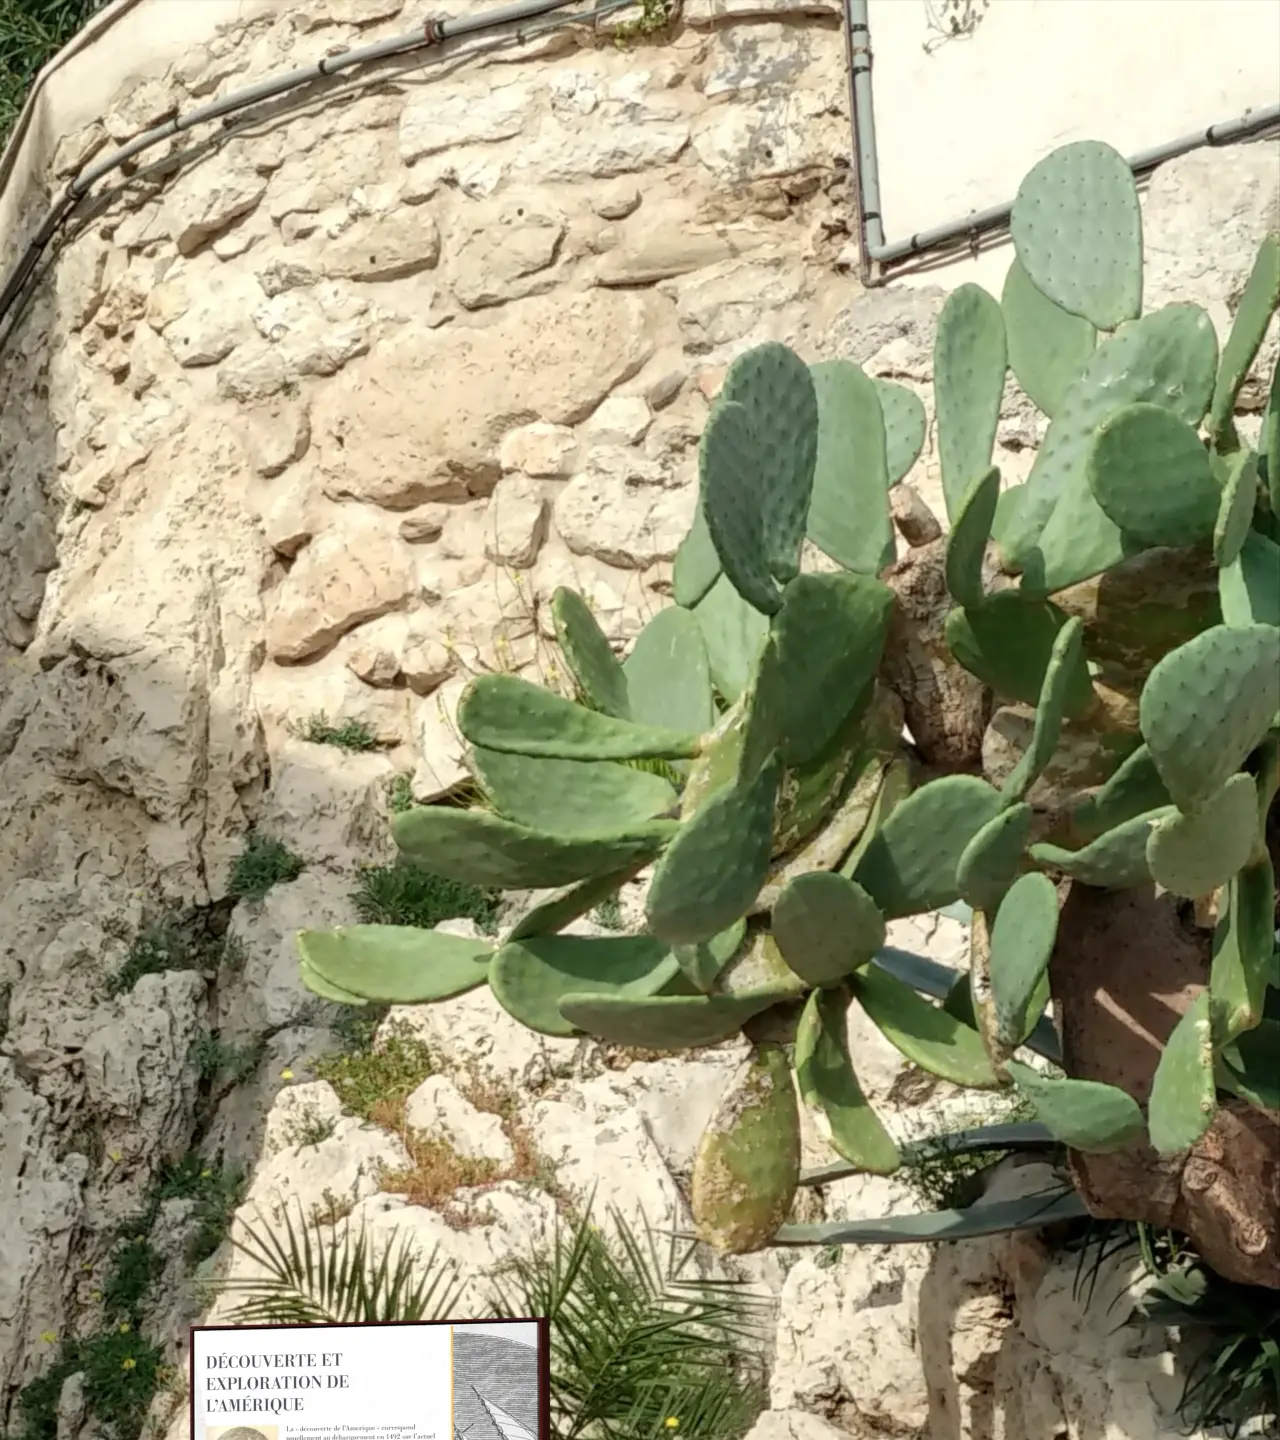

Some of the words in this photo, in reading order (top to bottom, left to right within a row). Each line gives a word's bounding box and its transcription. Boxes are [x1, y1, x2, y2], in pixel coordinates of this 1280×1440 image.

[206, 1352, 316, 1368] DÉCOUVERTE
[322, 1353, 343, 1366] ET
[206, 1375, 322, 1390] EXPLORATION
[327, 1375, 349, 1388] DE
[206, 1396, 304, 1415] L’AMÉRIQUE
[381, 1424, 416, 1433] correspond
